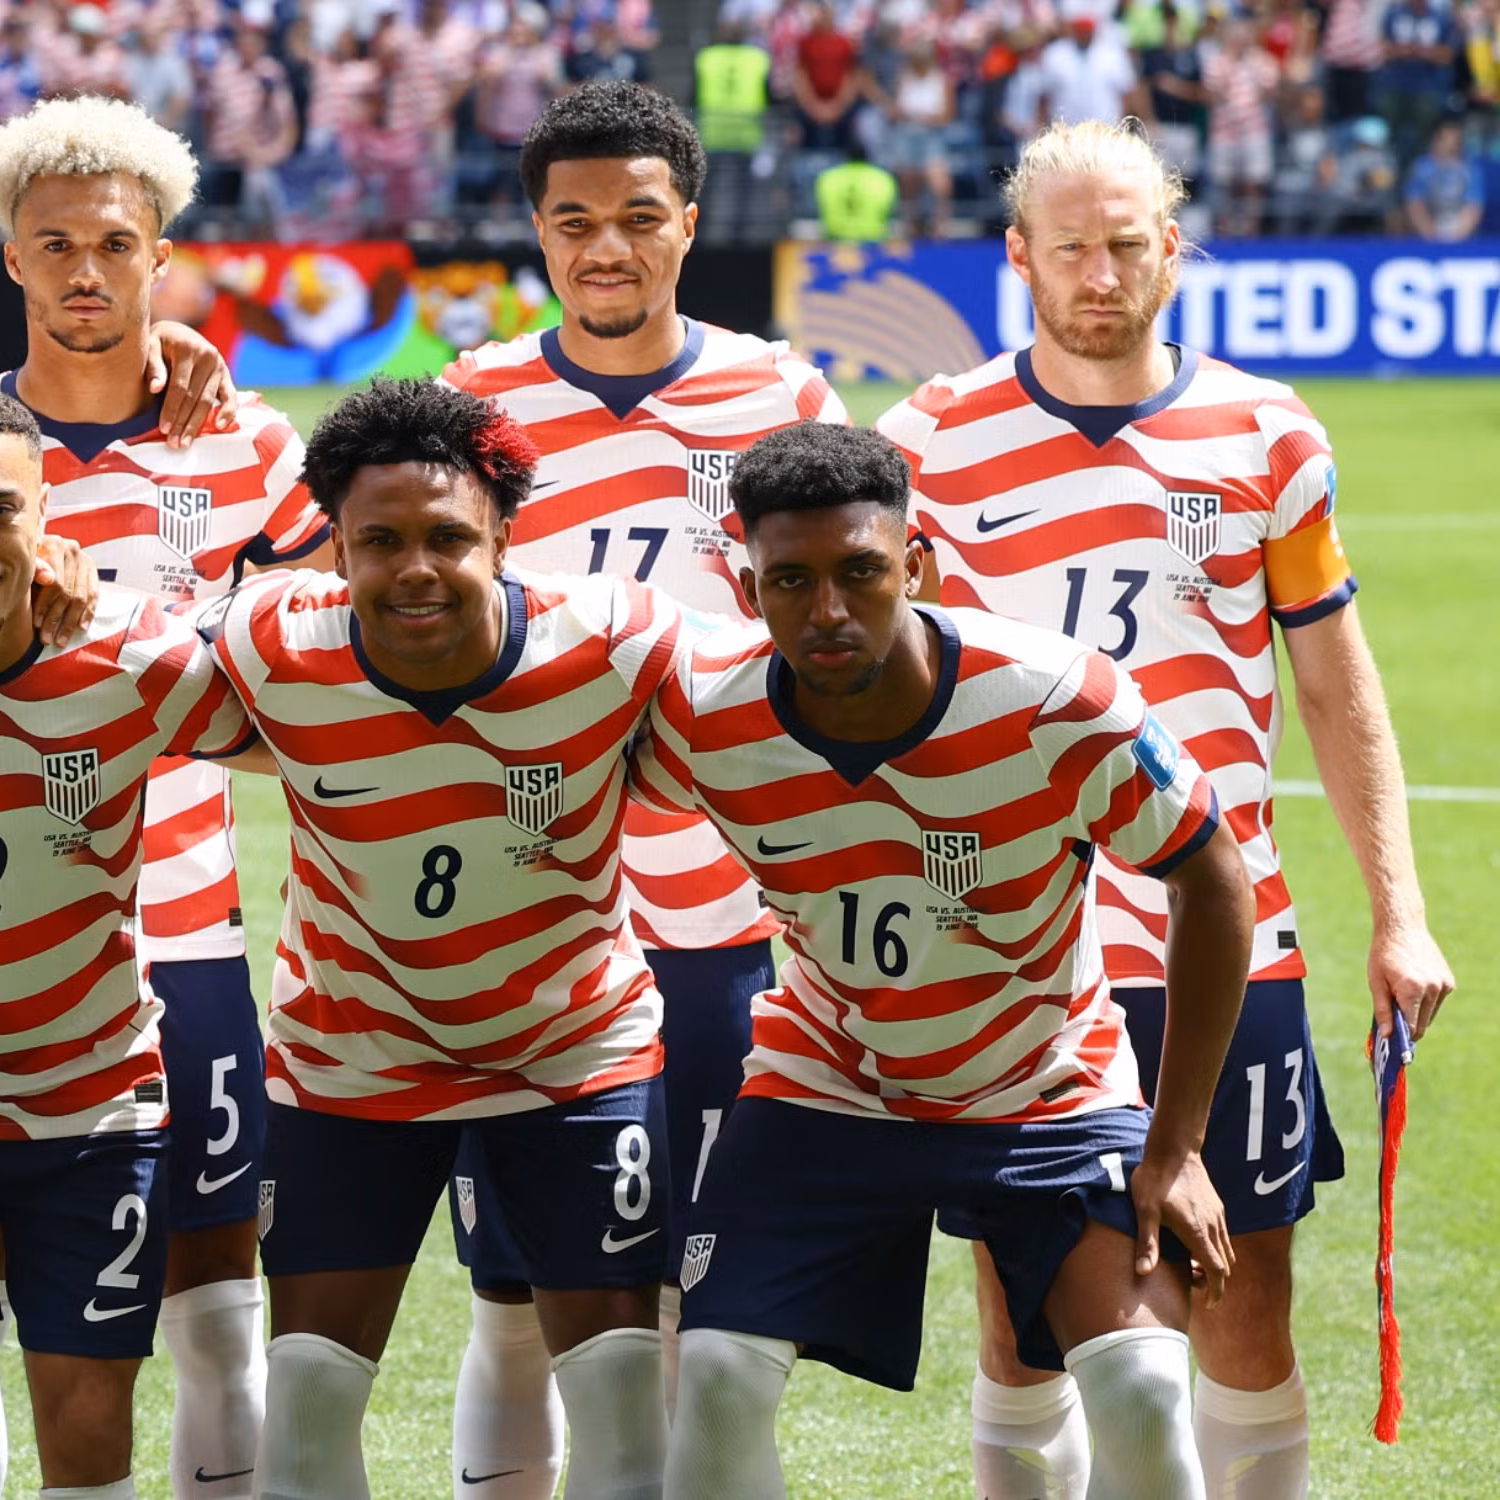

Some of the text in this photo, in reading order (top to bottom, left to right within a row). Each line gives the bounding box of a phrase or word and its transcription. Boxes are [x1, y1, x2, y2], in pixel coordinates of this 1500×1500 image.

[996, 256, 1500, 358] UTED ST
[691, 452, 739, 480] USA
[162, 490, 209, 518] USA
[1170, 496, 1218, 525] USA
[588, 526, 670, 582] 17
[1061, 567, 1150, 662] 13
[45, 753, 96, 784] USA
[508, 764, 560, 797] USA
[414, 844, 462, 919] 8
[924, 833, 978, 861] USA
[838, 890, 911, 978] 16
[206, 1053, 241, 1157] 5
[1244, 1047, 1306, 1161] 13
[613, 1123, 652, 1222] 8
[691, 1108, 723, 1203] 1
[95, 1193, 147, 1290] 2
[685, 1235, 714, 1260] USA
